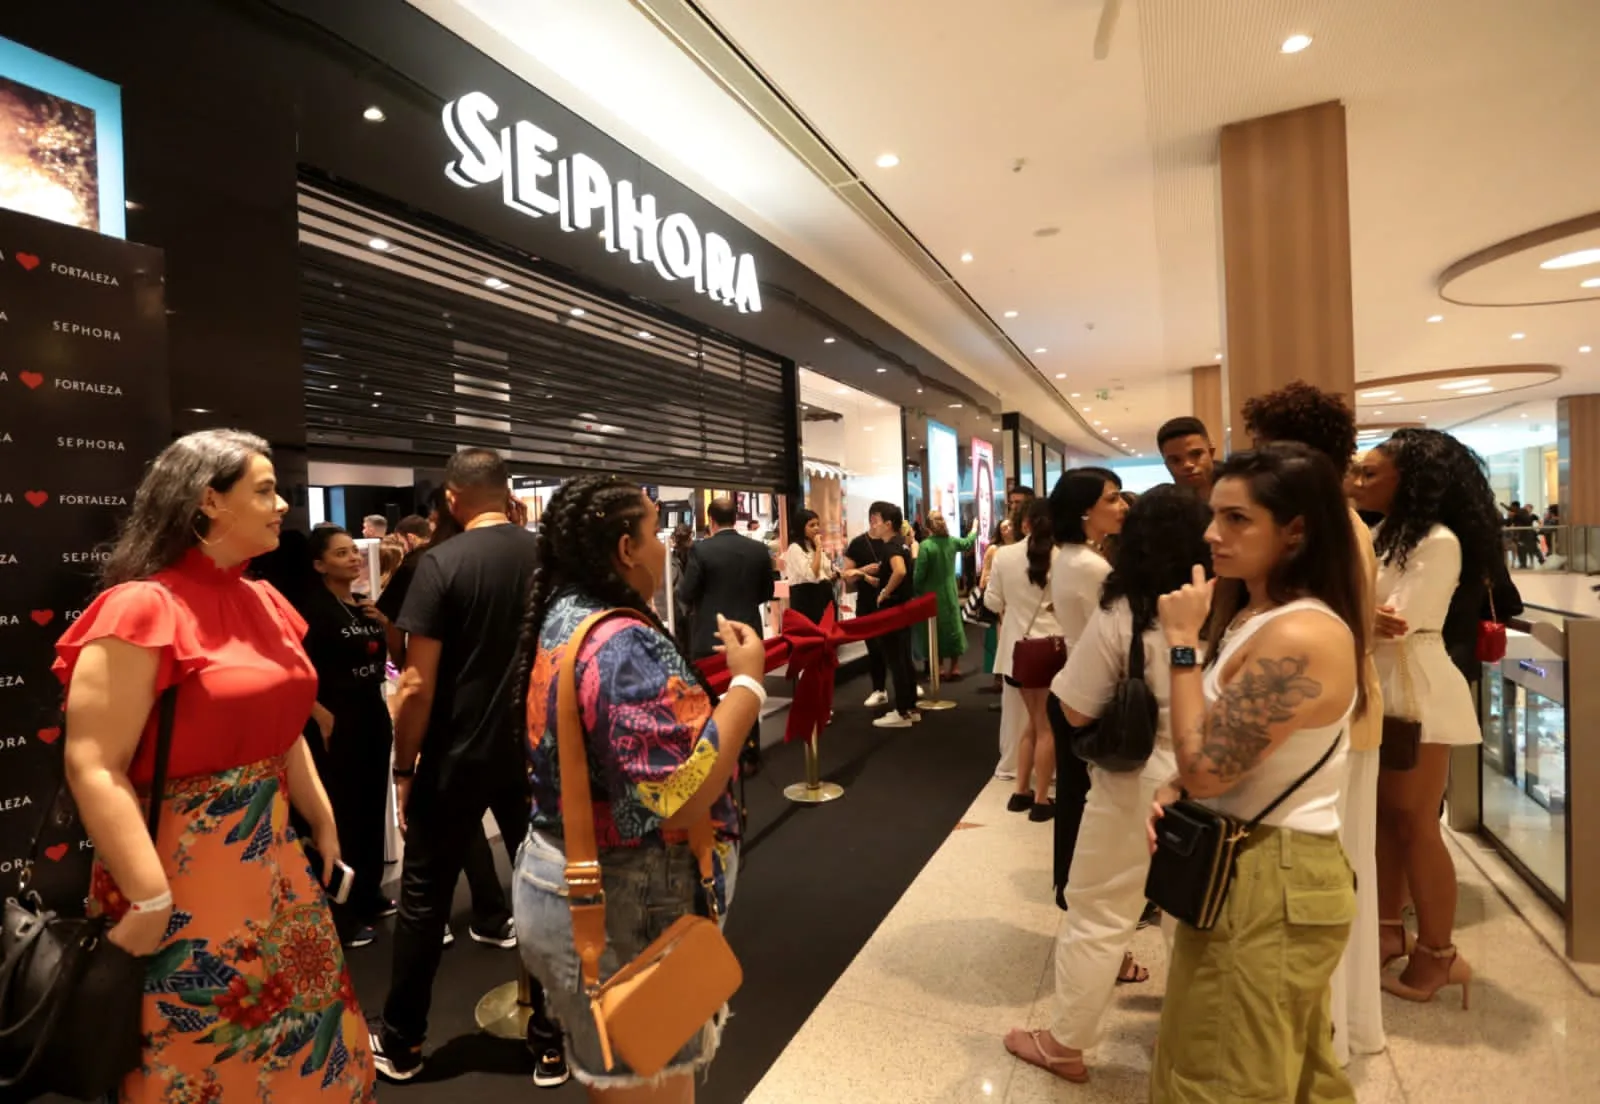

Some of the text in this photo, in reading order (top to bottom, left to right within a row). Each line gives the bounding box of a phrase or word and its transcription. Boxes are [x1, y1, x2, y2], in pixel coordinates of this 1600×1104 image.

[442, 91, 762, 314] SEPHORA
[50, 262, 120, 287] FORTALEZA
[52, 320, 121, 341] SEPHORA
[55, 378, 123, 396] FORTALEZA
[57, 436, 125, 451] SEPHORA
[59, 494, 127, 506] FORTALEZA
[62, 551, 112, 563] SEPHO
